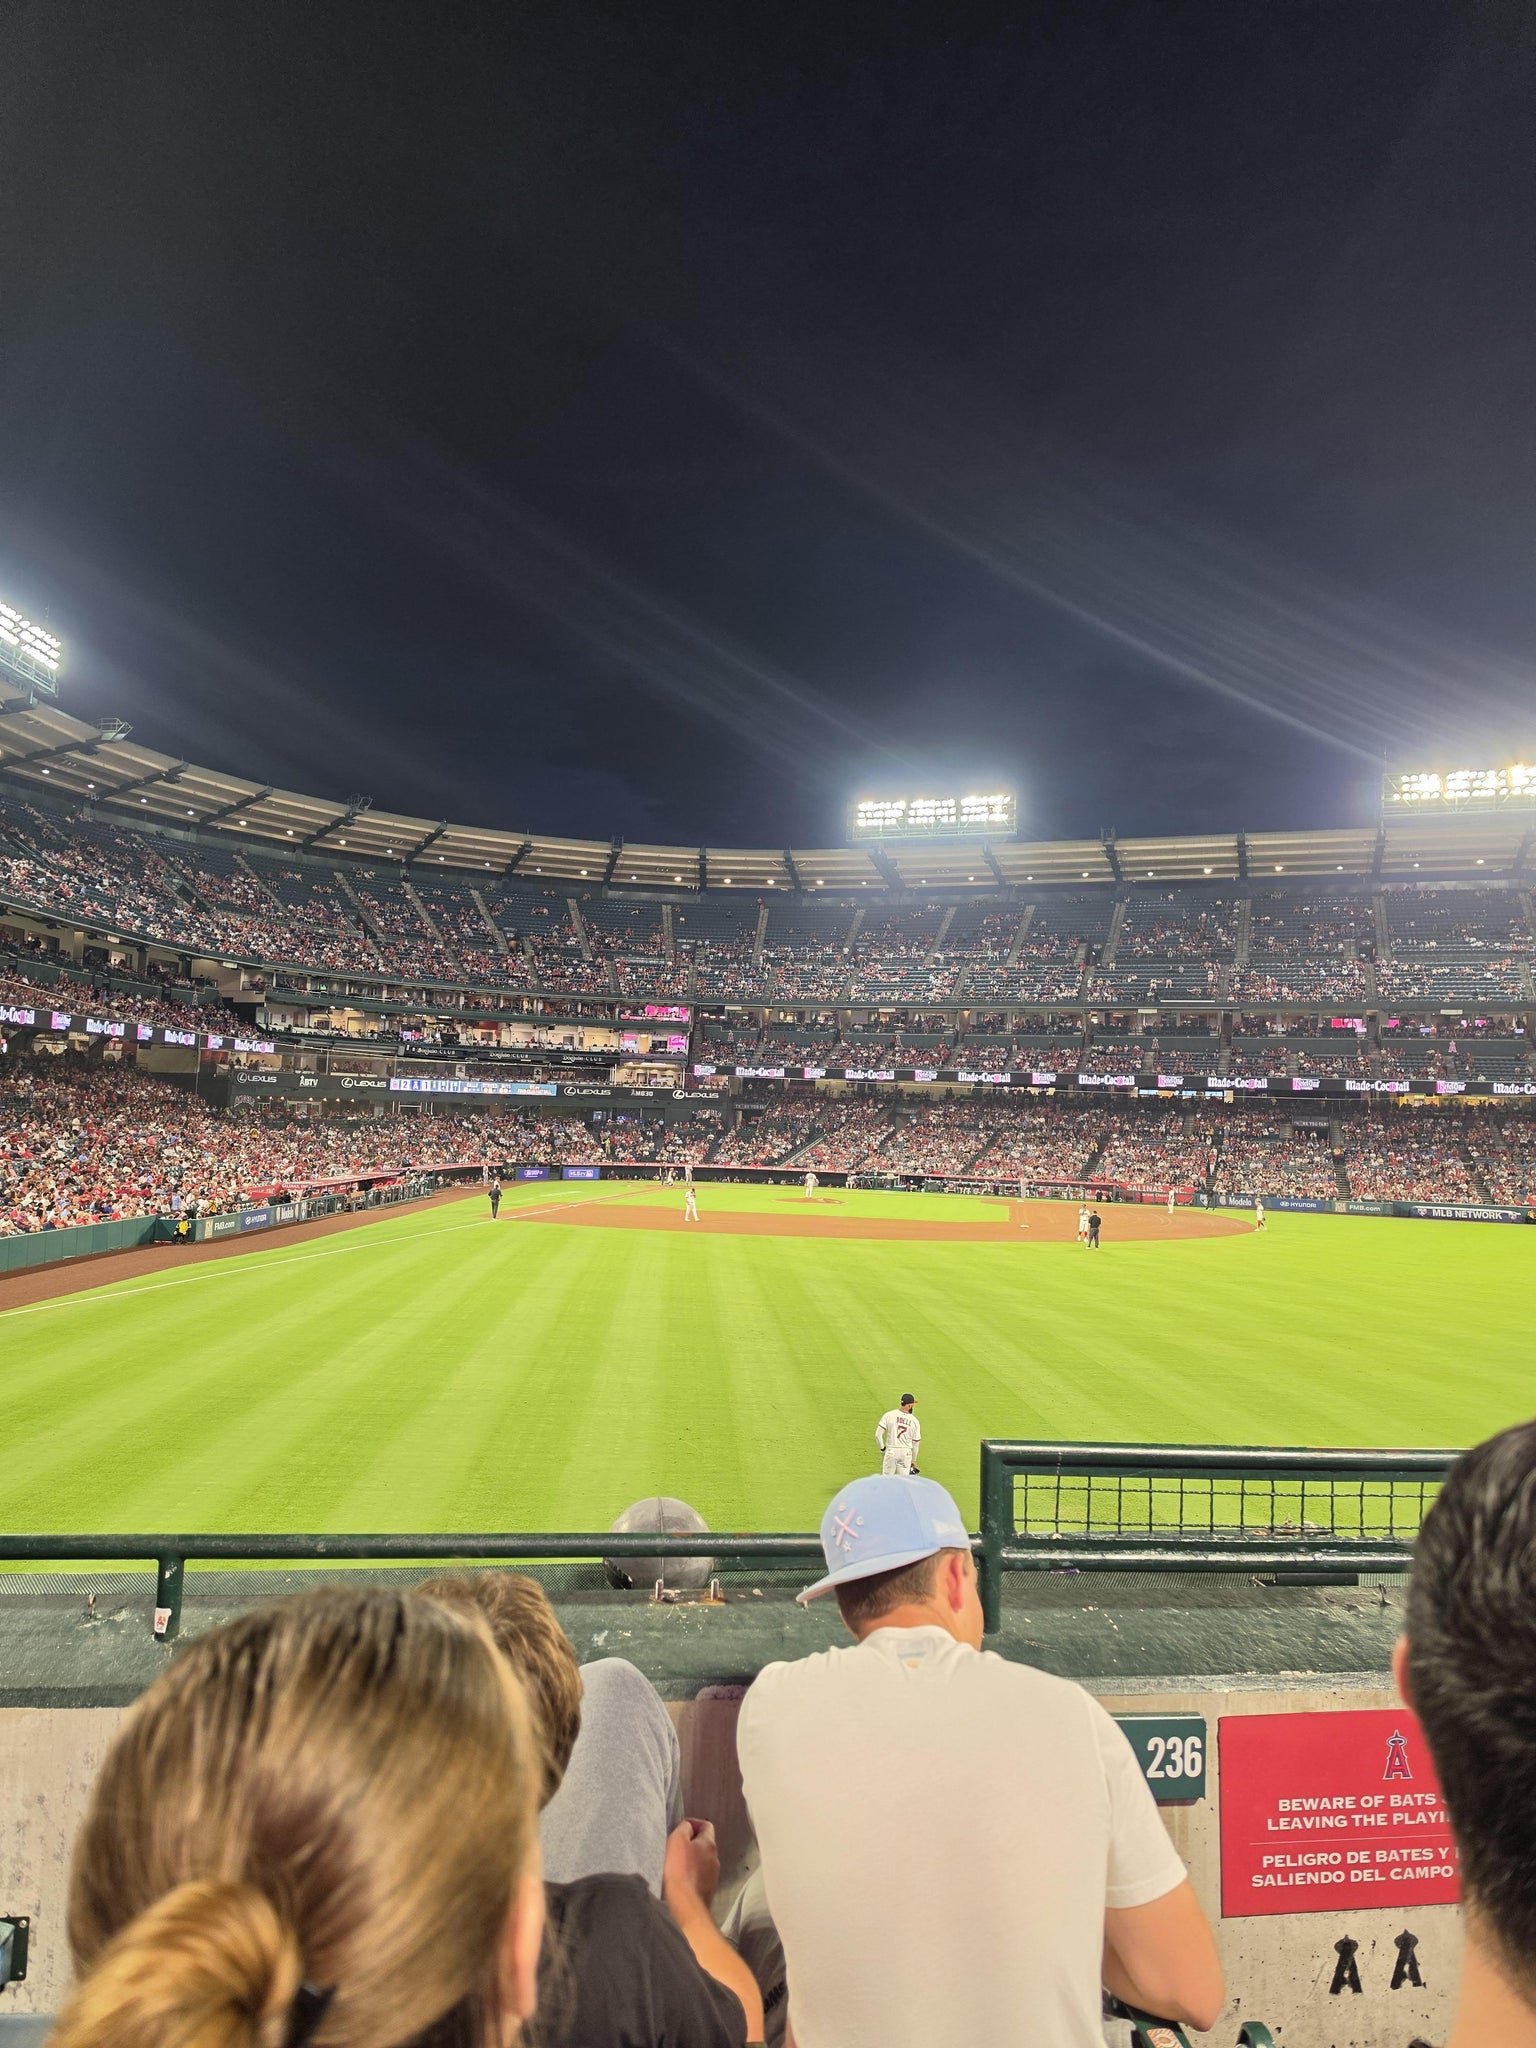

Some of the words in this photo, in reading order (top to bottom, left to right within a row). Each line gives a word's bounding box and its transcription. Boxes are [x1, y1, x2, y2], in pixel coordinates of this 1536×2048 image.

[247, 1075, 277, 1083] LEXUS
[353, 1080, 387, 1088] LEXUS
[576, 1088, 611, 1096] LEXUS
[684, 1091, 720, 1099] LEXUS
[1228, 1197, 1252, 1207] Modelo
[1290, 1201, 1317, 1209] HYUNDAI
[1349, 1204, 1381, 1212] FMB.com
[1432, 1208, 1453, 1218] MLB
[1454, 1209, 1503, 1220] NETWORK
[214, 1221, 236, 1231] FMB.com
[896, 1425, 908, 1439] 7
[1146, 1735, 1203, 1779] 236
[1278, 1796, 1356, 1813] BEWARE
[1360, 1795, 1385, 1809] OF
[1389, 1793, 1437, 1808] BATS
[1266, 1814, 1348, 1832] LEAVING
[1351, 1813, 1388, 1827] THE
[1392, 1810, 1450, 1826] PLAYI
[1262, 1851, 1342, 1869] PELIGRO
[1346, 1851, 1371, 1864] DE
[1375, 1848, 1434, 1864] BATES
[1437, 1847, 1450, 1860] Y
[1251, 1870, 1346, 1888] SALIENDO
[1350, 1869, 1386, 1883] DEL
[1389, 1865, 1454, 1881] CAMPO
